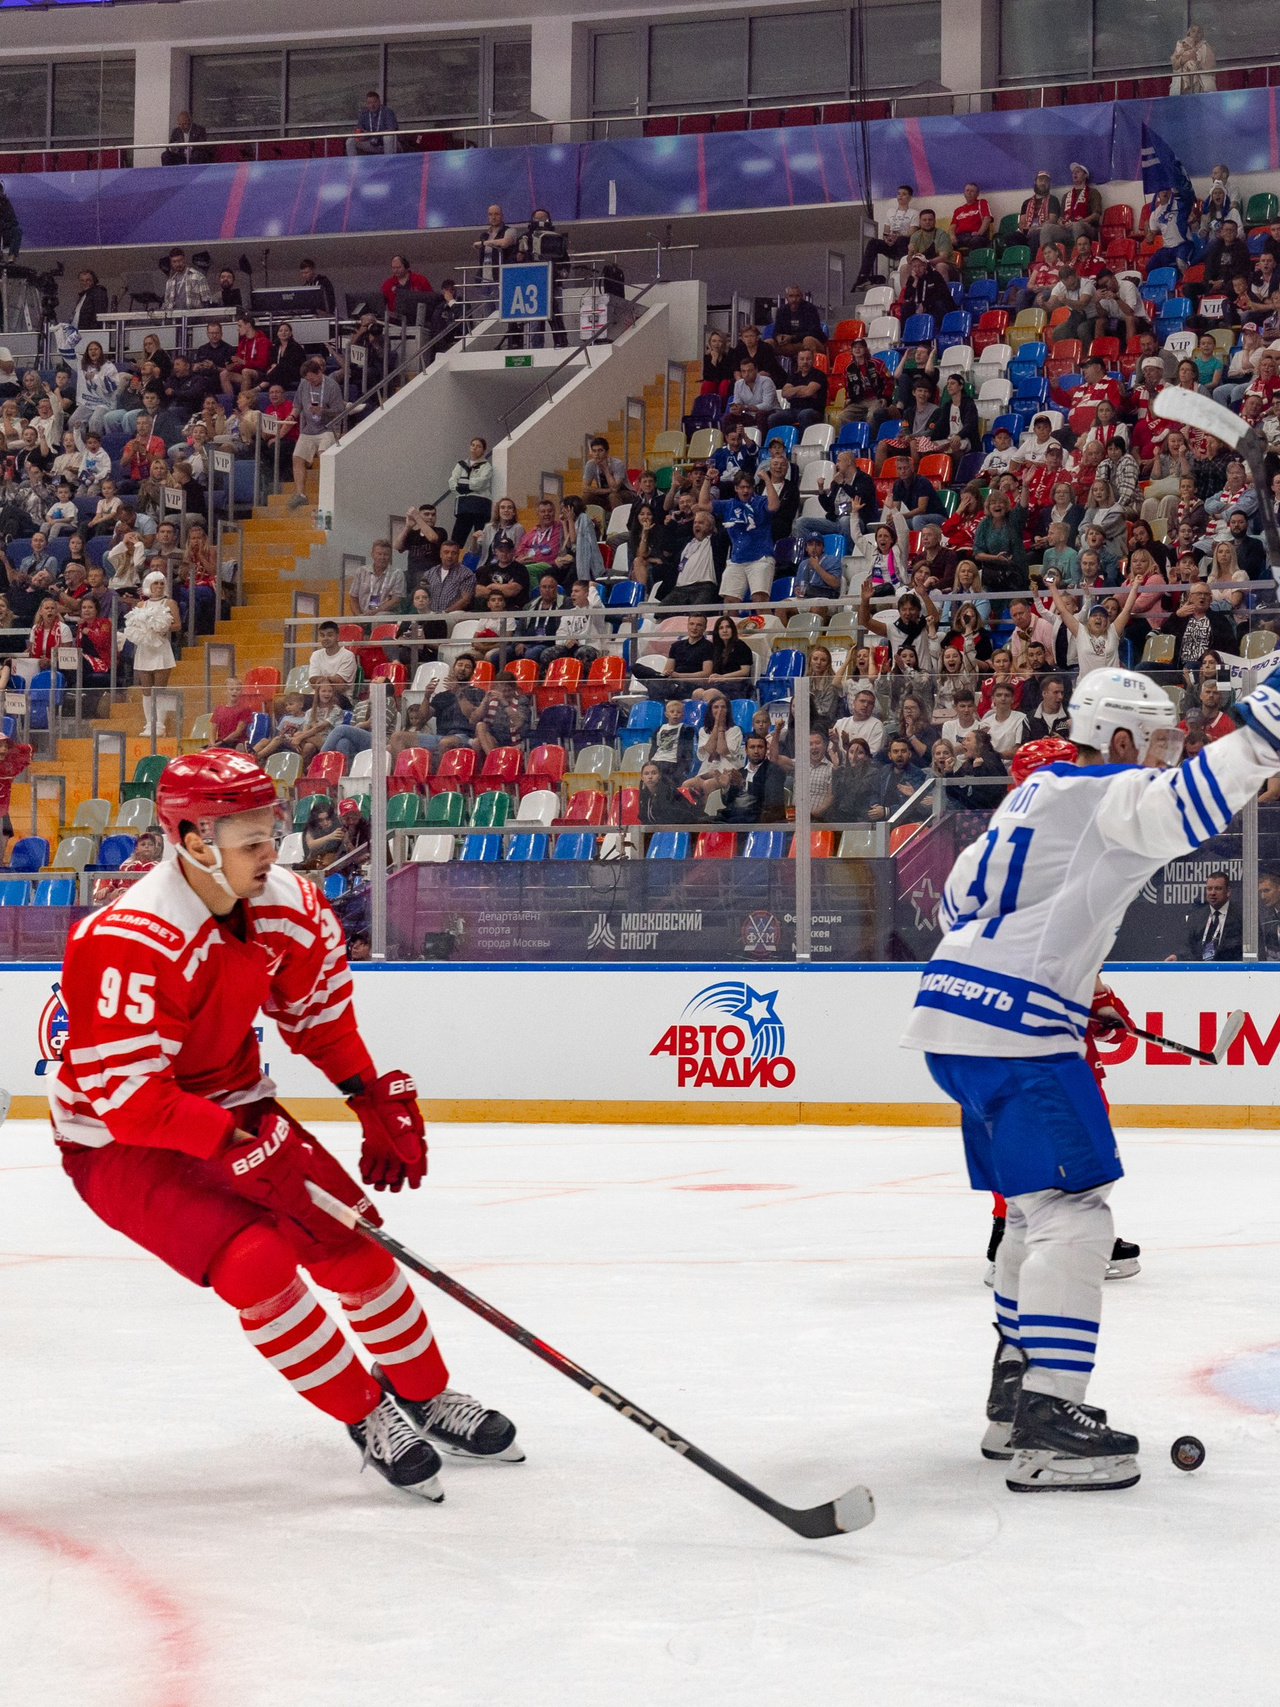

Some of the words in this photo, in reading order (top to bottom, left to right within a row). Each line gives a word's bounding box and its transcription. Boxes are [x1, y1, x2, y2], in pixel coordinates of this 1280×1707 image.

[510, 284, 538, 315] A3
[1170, 341, 1191, 350] VIP
[352, 350, 365, 362] VIP
[263, 420, 277, 432] VIP
[215, 456, 230, 468] VIP
[166, 493, 181, 505] VIP
[59, 655, 77, 663] ГОСТЬ
[1123, 678, 1146, 691] ВТБ
[7, 699, 25, 708] ГОСТЬ
[1163, 884, 1207, 904] СПОРТ
[478, 911, 541, 923] Департамент
[621, 908, 702, 931] МОСКОВСКИЙ
[784, 913, 842, 925] Ферация
[106, 912, 180, 943] OLIMPBET
[478, 925, 511, 938] спорта
[621, 932, 659, 950] СПОРТ
[747, 932, 775, 943] ФХМ
[478, 938, 511, 950] города
[513, 938, 550, 948] Москвы
[97, 966, 157, 1025] 95
[649, 1024, 746, 1057] АВТО
[678, 1056, 796, 1088] РАДИО
[589, 1384, 691, 1455] CCM
